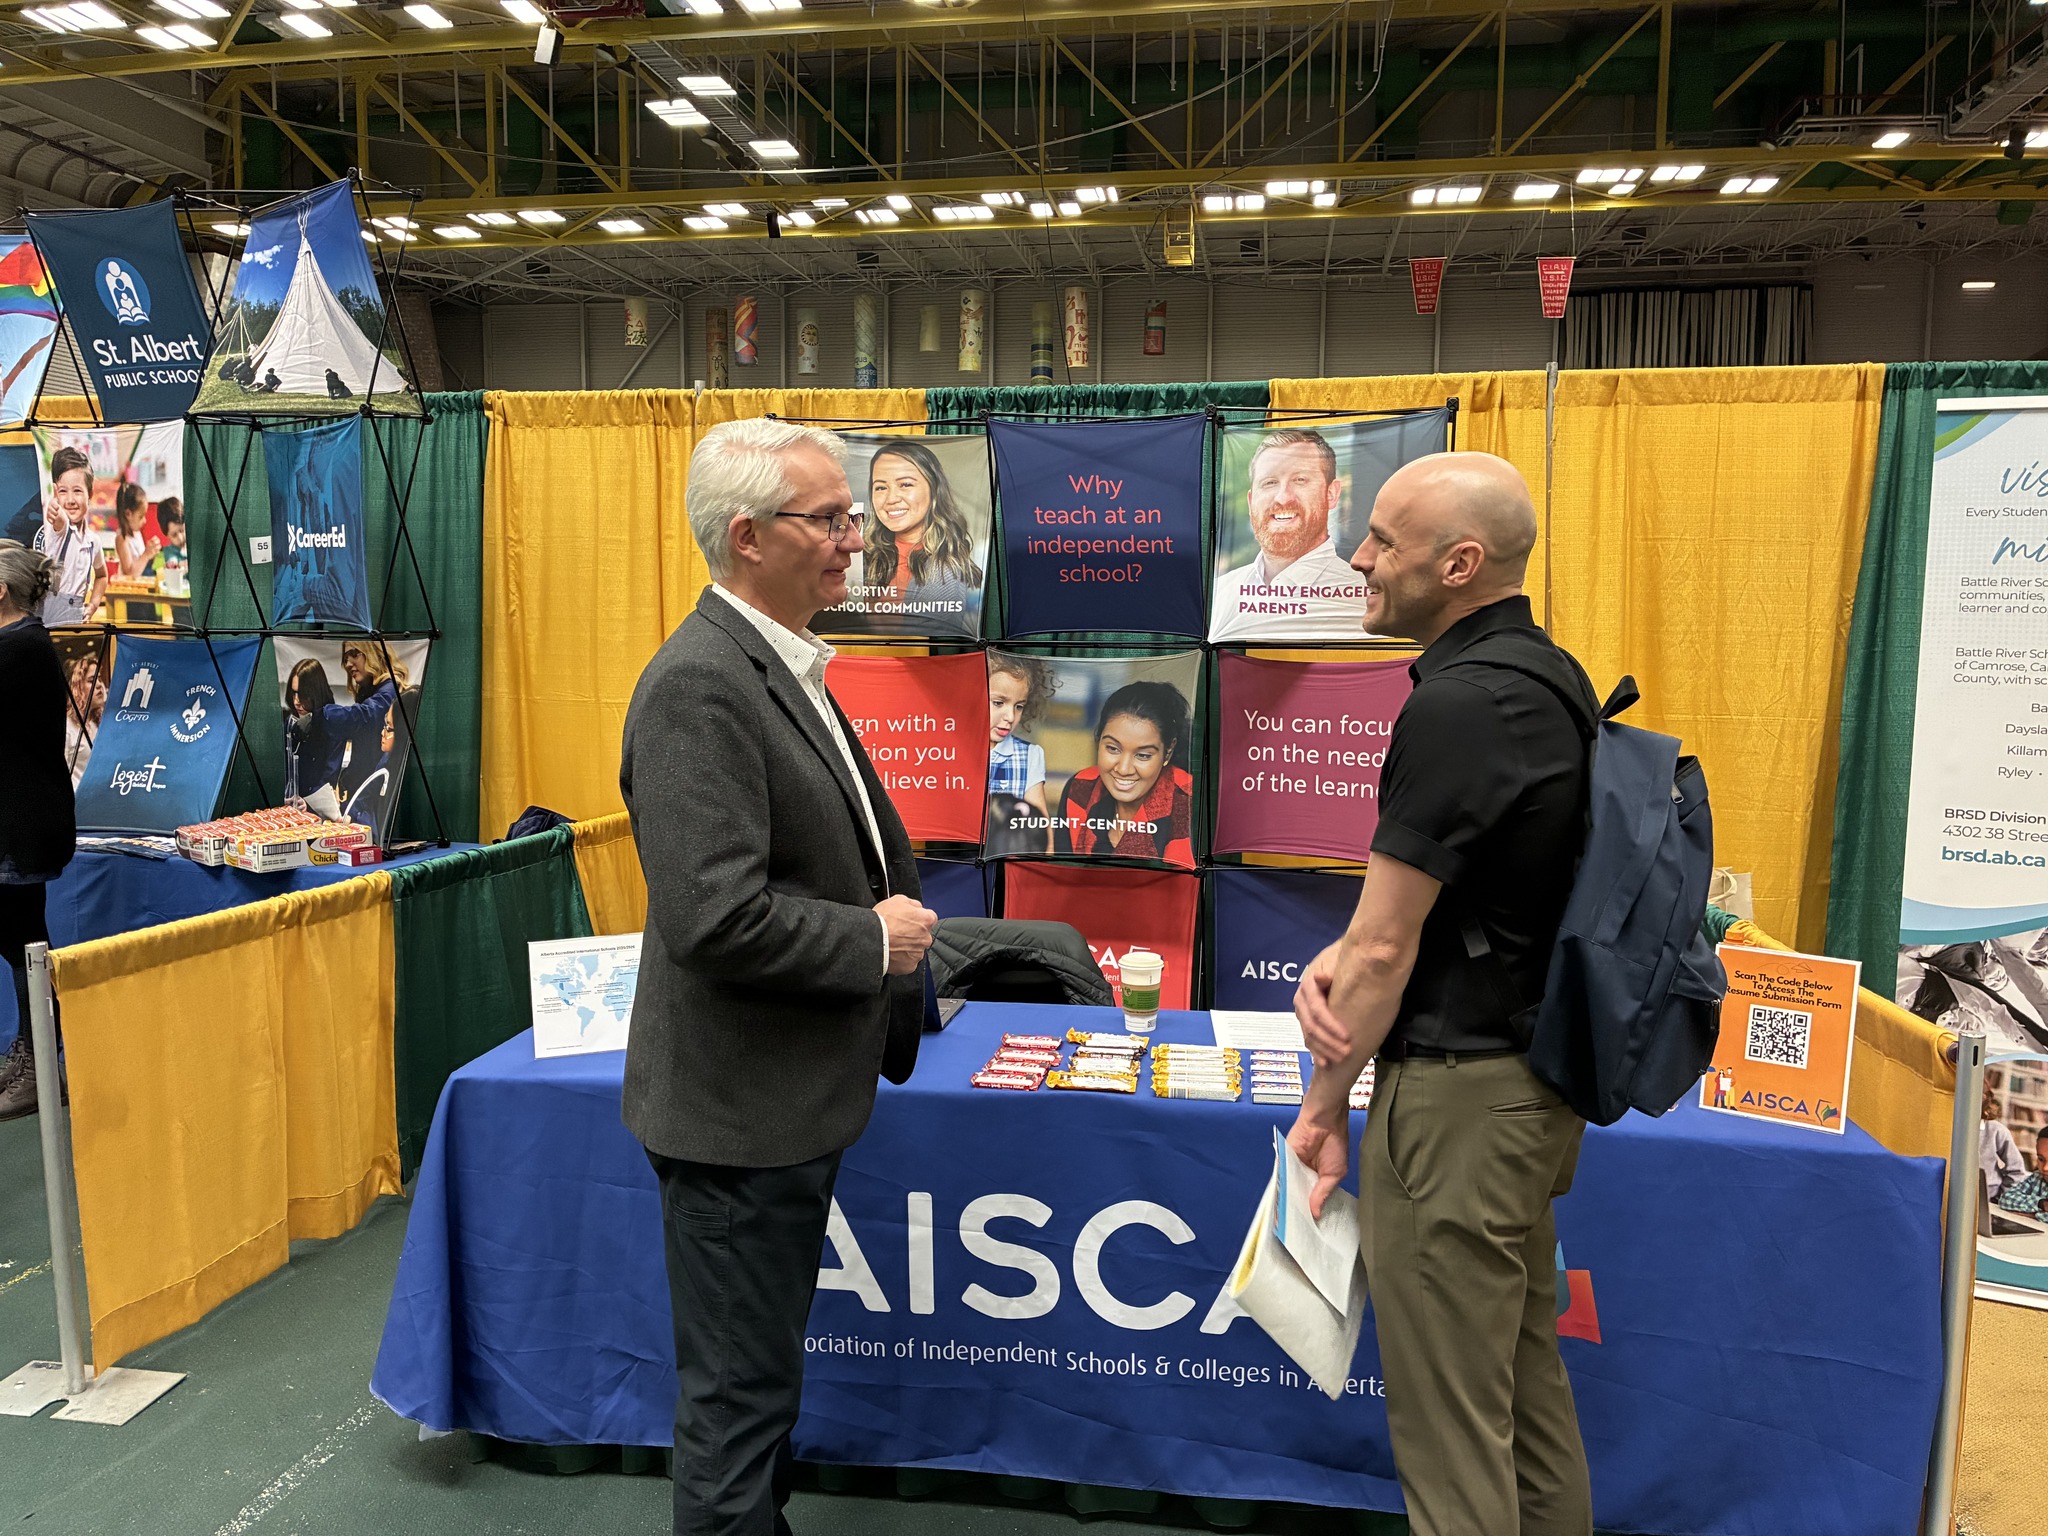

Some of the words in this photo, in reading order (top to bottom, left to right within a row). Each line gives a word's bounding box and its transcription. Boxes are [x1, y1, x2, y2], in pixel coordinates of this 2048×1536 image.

[93, 339, 127, 366] St.
[131, 334, 204, 363] Albert
[104, 372, 148, 388] PUBLIC
[149, 370, 204, 385] SCHOO
[1069, 474, 1123, 500] Why
[1034, 506, 1097, 525] teach
[1104, 508, 1126, 524] at
[1134, 509, 1161, 524] an
[1966, 507, 2000, 518] Every
[2002, 507, 2048, 517] Studen
[296, 524, 346, 548] CareerEd
[258, 542, 268, 550] 55
[1028, 536, 1174, 558] independent
[1059, 564, 1142, 583] school?
[1961, 577, 1998, 587] Battle
[2001, 578, 2032, 587] River
[1240, 585, 1297, 597] HIGHLY
[1960, 590, 2045, 602] communities,
[874, 601, 963, 614] COMMUNITIES
[1239, 602, 1308, 614] PARENTS
[1959, 603, 2001, 613] learner
[2004, 604, 2029, 613] and
[2032, 605, 2048, 614] co
[1956, 648, 1992, 658] Battle
[1996, 649, 2027, 658] River
[1954, 660, 1968, 670] of
[1969, 661, 2028, 672] Camrose,
[2030, 662, 2048, 672] Ca
[1954, 673, 2001, 686] County,
[2004, 674, 2032, 684] with
[186, 684, 216, 697] FRENCH
[846, 715, 879, 738] gn
[886, 713, 936, 732] with
[944, 717, 956, 732] a
[1244, 709, 1284, 732] You
[1291, 716, 1332, 734] can
[1340, 714, 1392, 736] focu
[170, 723, 210, 742] IMMERSION
[864, 743, 907, 760] ion
[914, 746, 956, 766] you
[1248, 746, 1274, 761] on
[1282, 744, 1320, 764] the
[1328, 748, 1386, 768] need
[2008, 746, 2048, 756] Killam
[945, 771, 970, 790] in.
[1998, 766, 2033, 780] Ryley
[1242, 772, 1264, 792] of
[1270, 773, 1307, 794] the
[1315, 775, 1378, 798] learn
[1010, 817, 1158, 834] STUDENT-CENTRED
[1944, 808, 1986, 820] BRSD
[1990, 811, 2046, 825] Division
[1942, 825, 1982, 838] 4302
[1985, 828, 2005, 840] 38
[2008, 829, 2048, 843] Stree
[1942, 846, 2046, 868] brsd.ab.ca
[1734, 970, 1756, 980] Scan
[1758, 974, 1774, 982] The
[1777, 976, 1802, 986] Code
[1803, 980, 1833, 991] Below
[1752, 981, 1764, 990] To
[1765, 983, 1795, 994] Access
[1798, 987, 1814, 997] The
[1726, 986, 1760, 998] Resume
[1762, 990, 1814, 1006] Submission
[1816, 998, 1842, 1009] Form
[1740, 1090, 1809, 1115] AISCA
[804, 1333, 886, 1358] ociation
[894, 1338, 915, 1358] of
[923, 1340, 1058, 1368] Independent
[1066, 1352, 1146, 1376] Schools
[1156, 1356, 1170, 1376] &
[1178, 1358, 1270, 1387] Colleges
[1280, 1365, 1298, 1388] in
[1307, 1374, 1386, 1397] Aerta
